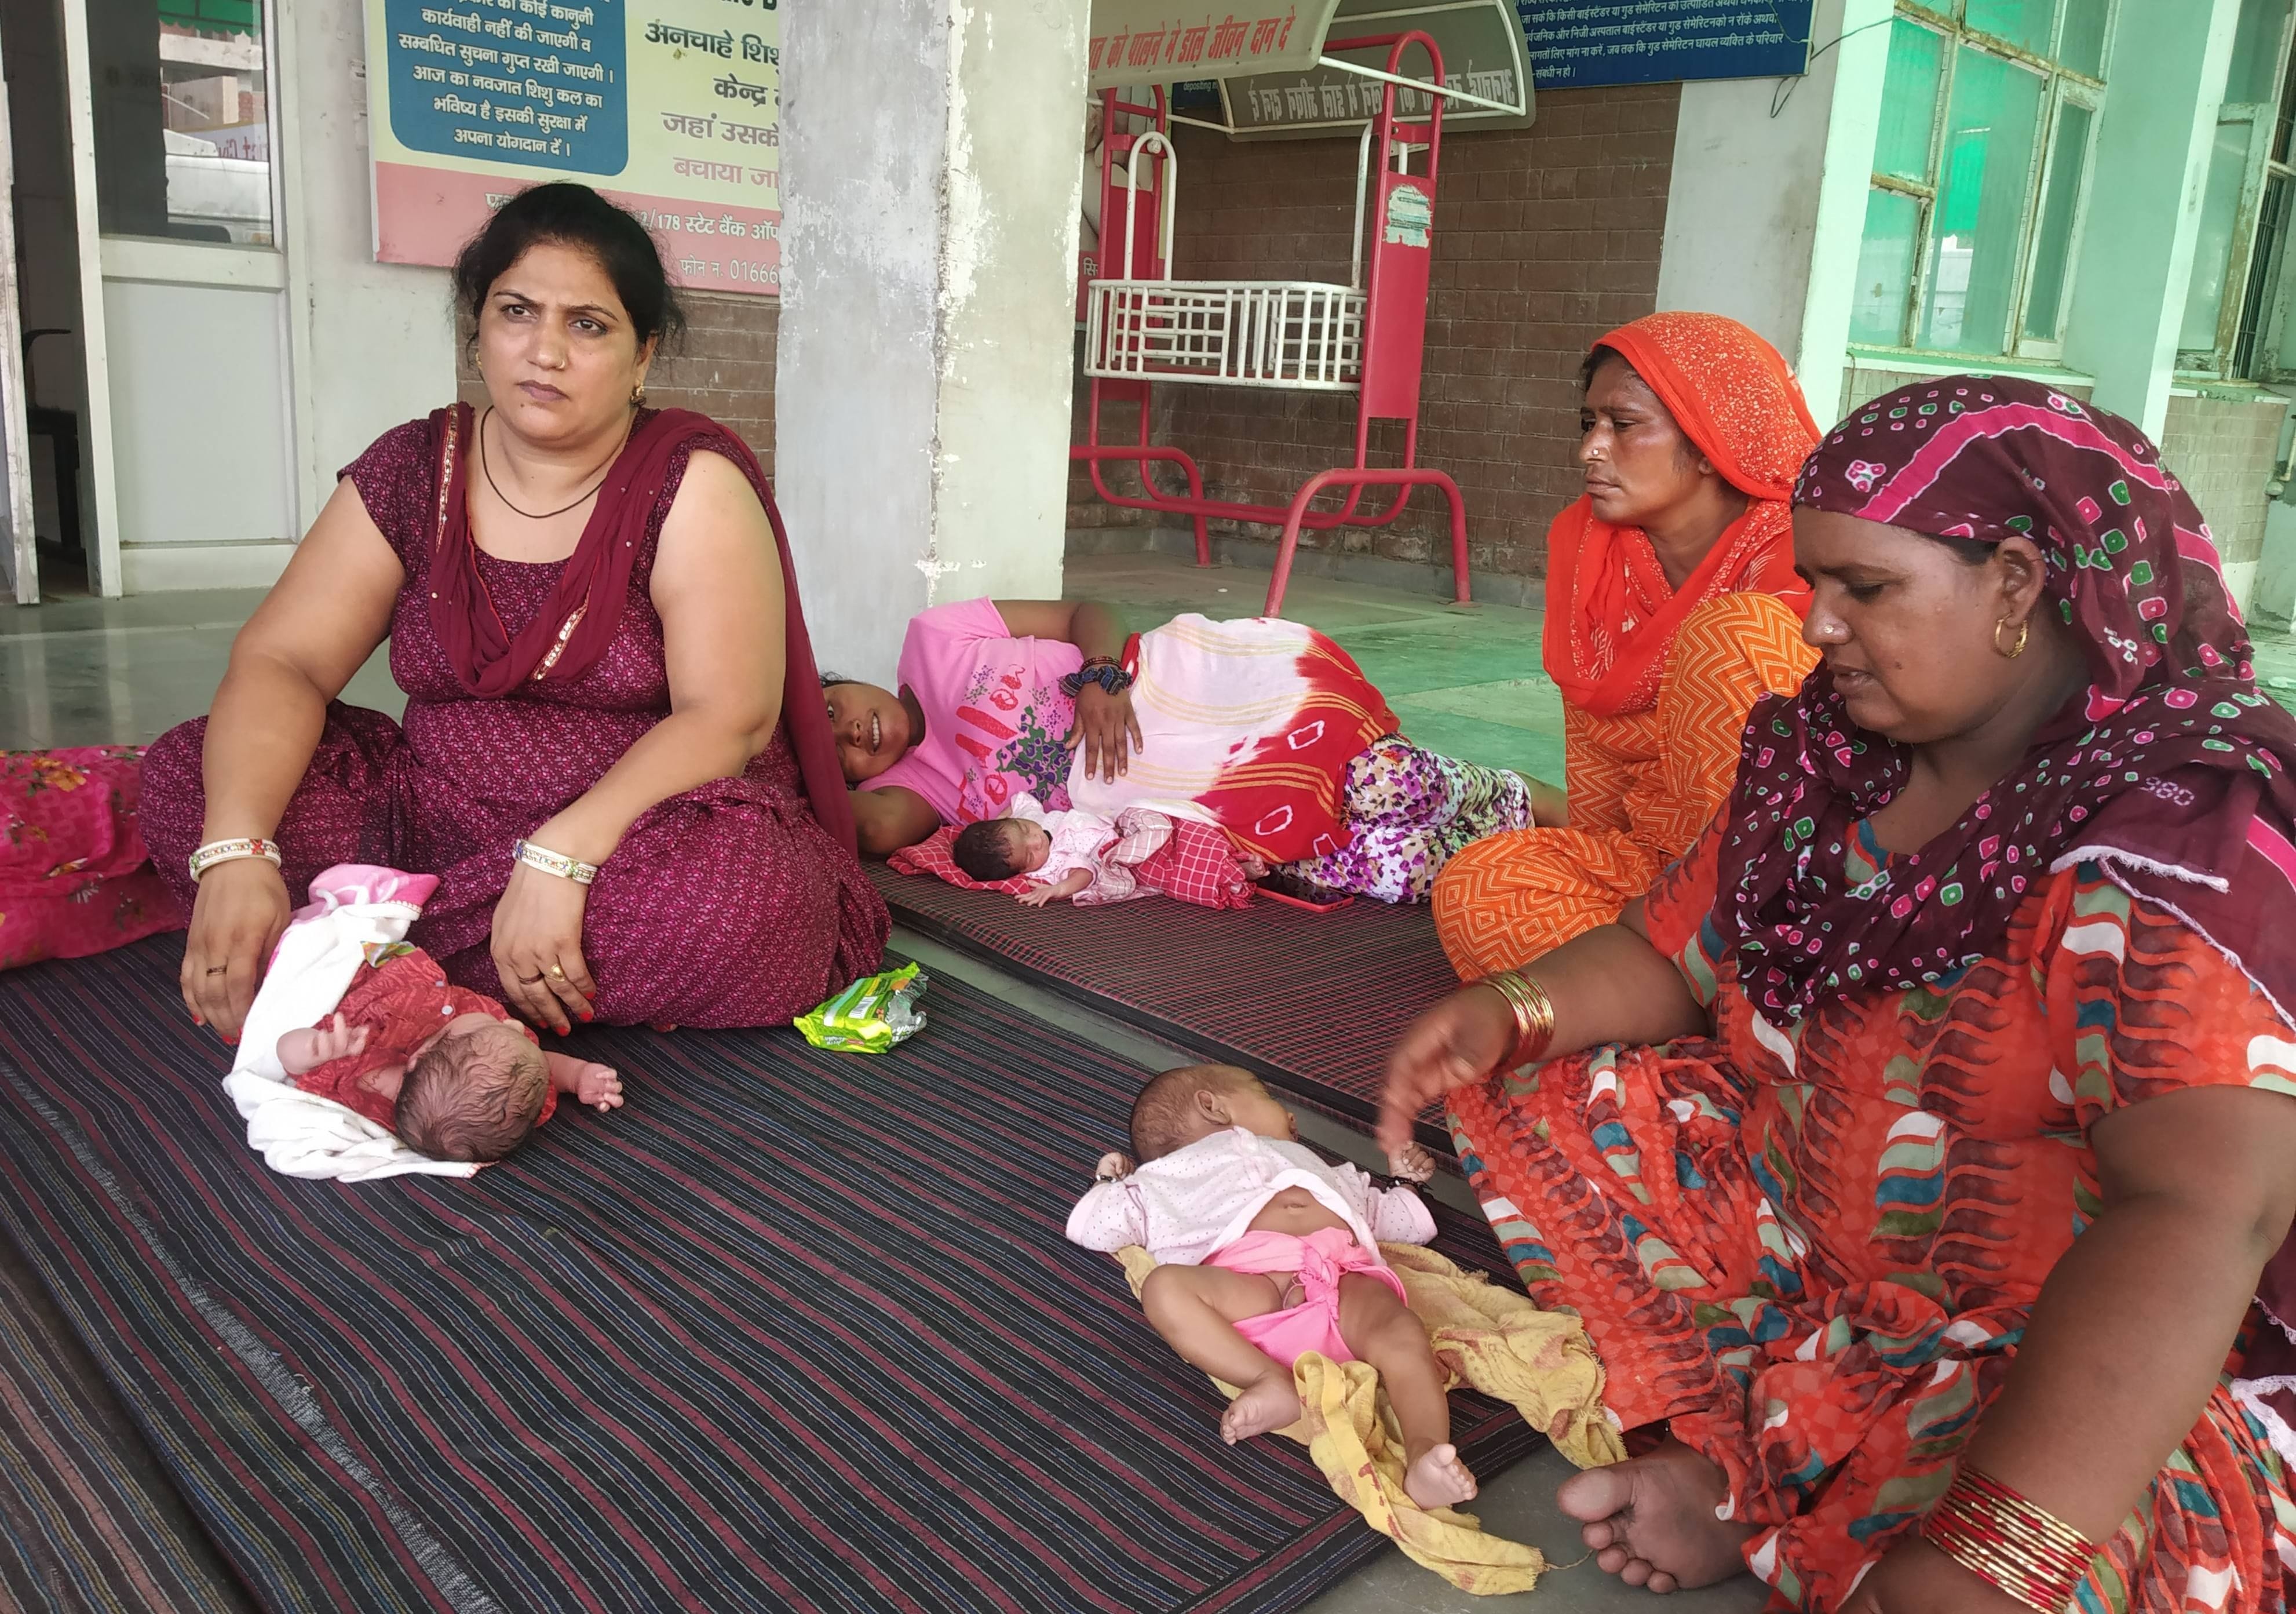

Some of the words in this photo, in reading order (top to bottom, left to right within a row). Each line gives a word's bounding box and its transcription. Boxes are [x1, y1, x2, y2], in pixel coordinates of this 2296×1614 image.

[1532, 10, 1546, 24] सके
[1546, 9, 1556, 22] कि
[1557, 7, 1576, 21] किसी
[1611, 6, 1620, 17] या
[1621, 5, 1634, 19] गुड
[1571, 24, 1589, 39] निजी
[1589, 25, 1622, 38] अस्पताल
[1658, 21, 1667, 31] या
[1668, 20, 1681, 35] गुड
[1728, 16, 1735, 26] न
[421, 8, 481, 33] कार्यवाही
[484, 18, 513, 38] नहीं
[514, 22, 532, 42] की
[535, 30, 578, 50] जाएगी
[581, 38, 591, 52] व
[645, 23, 734, 59] अनचाहे
[1107, 24, 1130, 68] को
[1208, 15, 1251, 59] जीवन
[1250, 18, 1282, 54] दान
[1607, 45, 1619, 55] जब
[1621, 44, 1634, 54] तक
[1636, 40, 1646, 53] कि
[1647, 42, 1660, 56] गुड
[1695, 38, 1719, 49] घायल
[1745, 32, 1754, 45] के
[1755, 30, 1784, 45] परिवार
[398, 34, 456, 56] सम्बधित
[459, 44, 498, 66] सुचना
[502, 52, 530, 74] गुप्त
[533, 55, 560, 74] रखी
[562, 62, 604, 82] जाएगी
[413, 65, 446, 83] आज
[450, 71, 469, 87] का
[472, 75, 522, 95] नवजात
[525, 79, 553, 107] शिशु
[556, 89, 583, 105] कल
[585, 93, 603, 108] का
[713, 73, 769, 107] केन्द्र
[434, 94, 477, 116] भविष्य
[480, 99, 491, 119] है
[494, 106, 534, 125] इसकी
[537, 113, 572, 133] सुरक्षा
[574, 115, 588, 133] में
[661, 112, 717, 139] जहां
[454, 129, 493, 146] अपना
[497, 131, 547, 154] योगदान
[550, 138, 562, 155] दें
[673, 156, 743, 184] बचाया
[685, 212, 715, 234] स्टेट
[718, 214, 747, 236] बैंक
[680, 255, 706, 276] फोन
